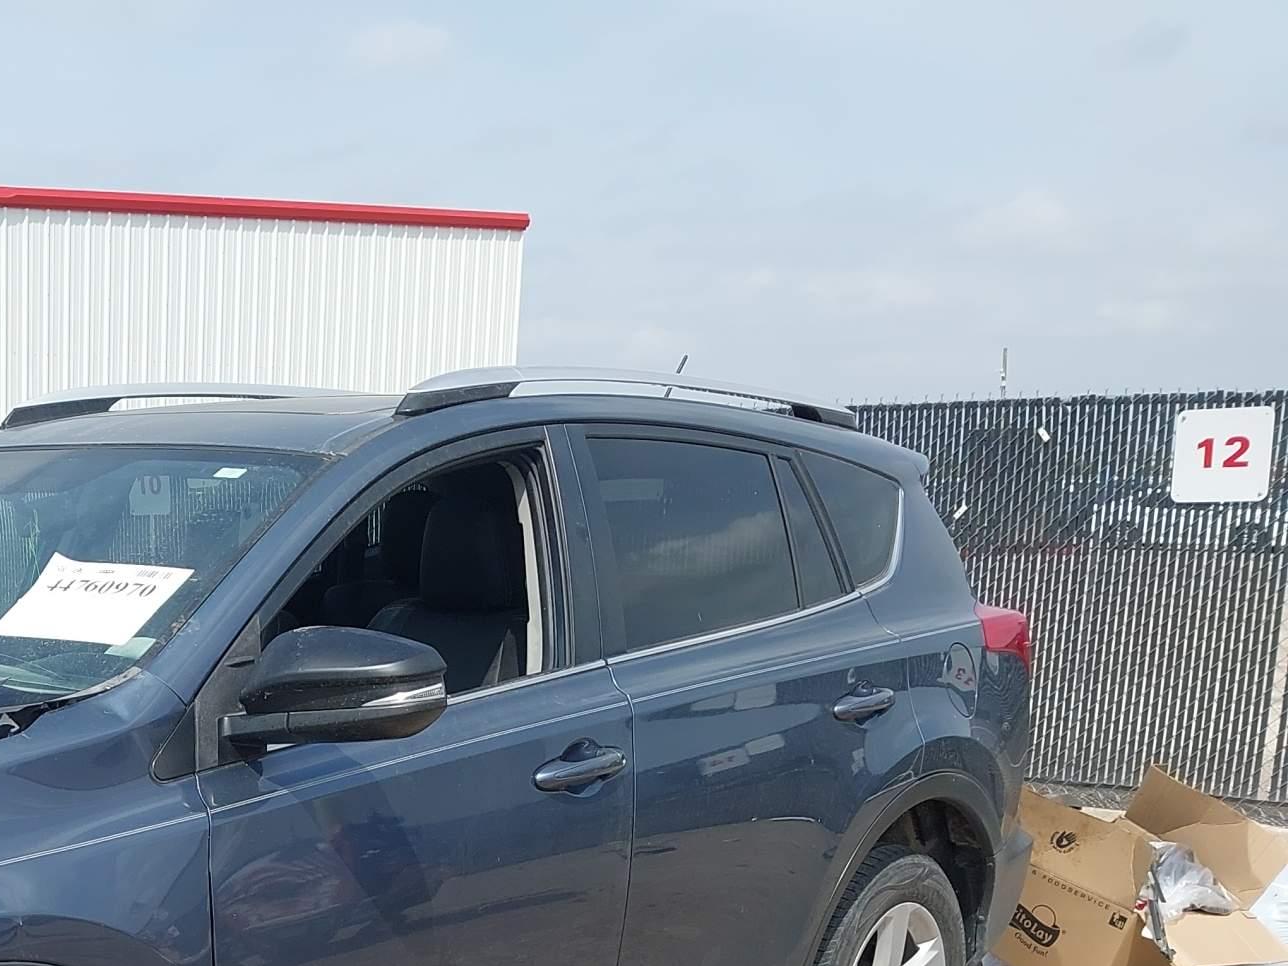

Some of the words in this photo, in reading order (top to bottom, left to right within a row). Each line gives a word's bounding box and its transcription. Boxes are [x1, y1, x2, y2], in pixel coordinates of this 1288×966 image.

[1197, 436, 1250, 469] 12
[47, 578, 158, 598] 44760970
[1042, 874, 1111, 911] FOODSERVICE
[1014, 932, 1033, 950] Good
